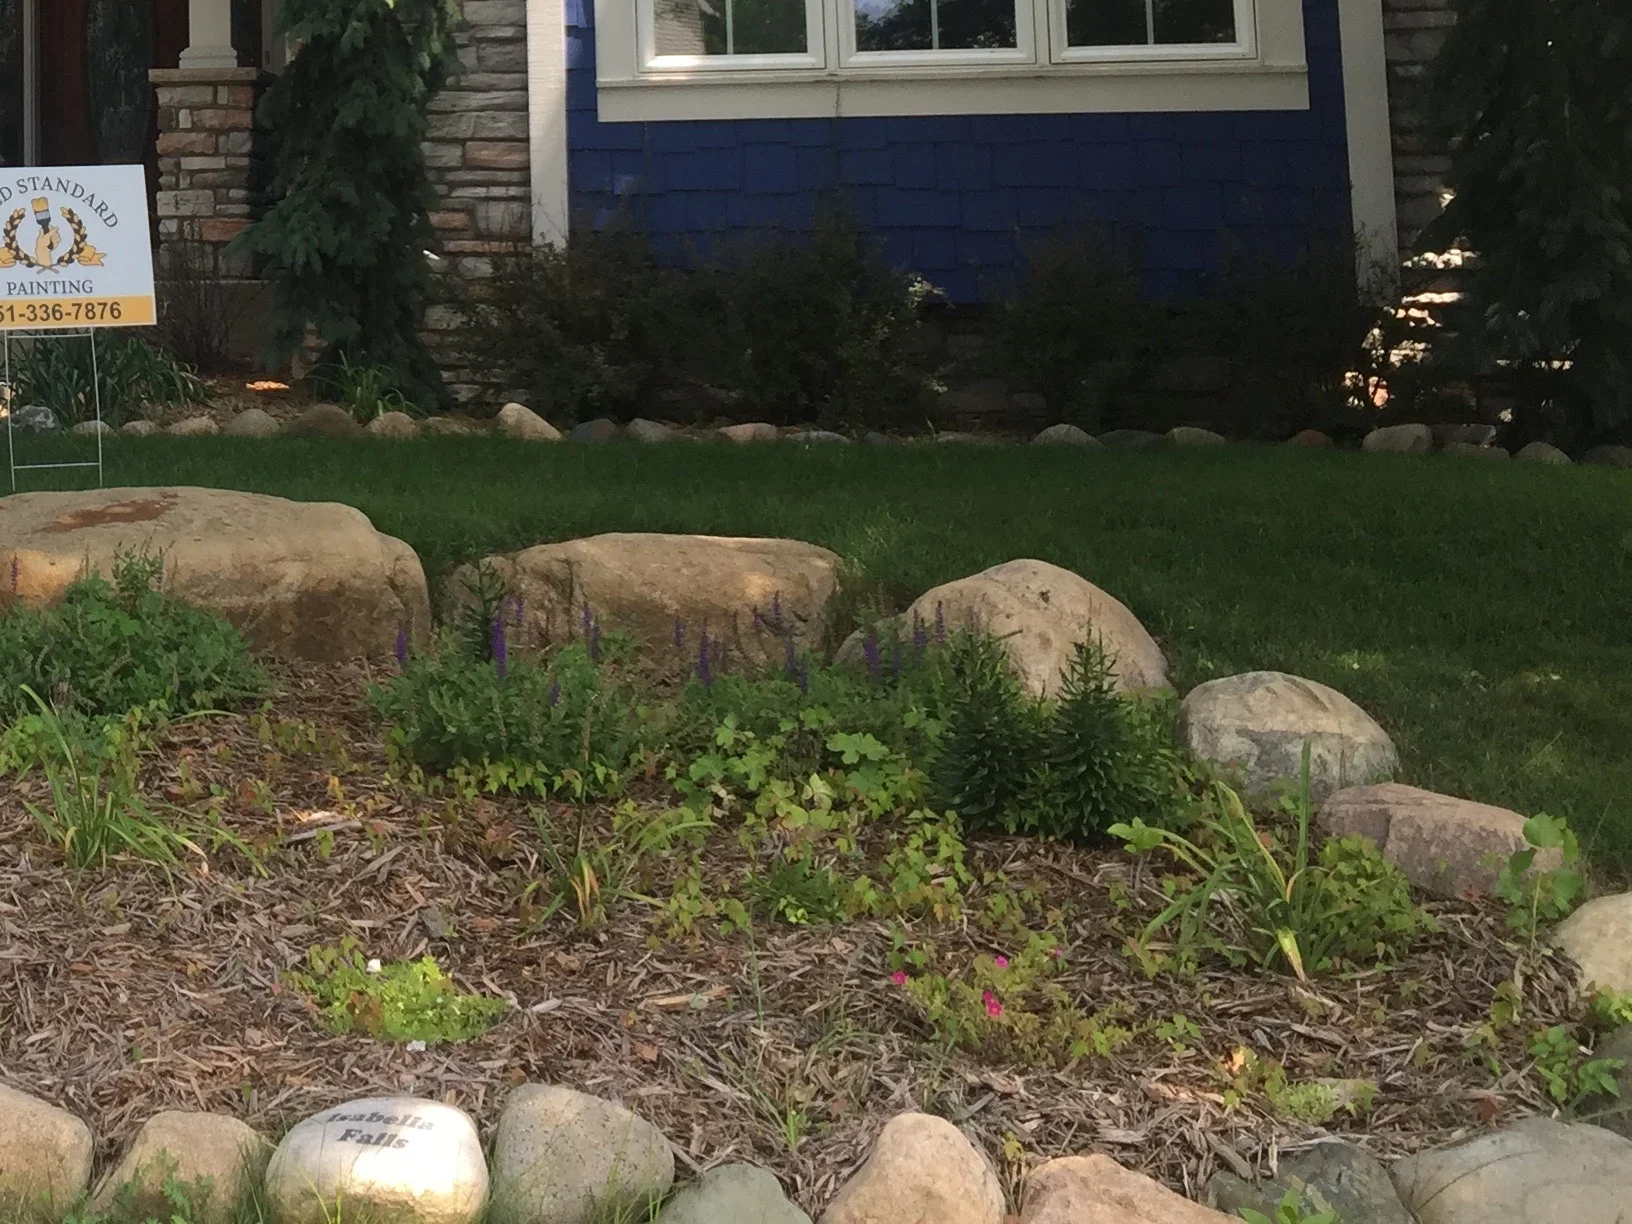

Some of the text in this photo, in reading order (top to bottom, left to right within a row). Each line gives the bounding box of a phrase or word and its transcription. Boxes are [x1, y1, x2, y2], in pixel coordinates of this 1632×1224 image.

[16, 176, 118, 229] STANDARD
[6, 279, 94, 296] PAINTING
[337, 1128, 409, 1149] Falls
